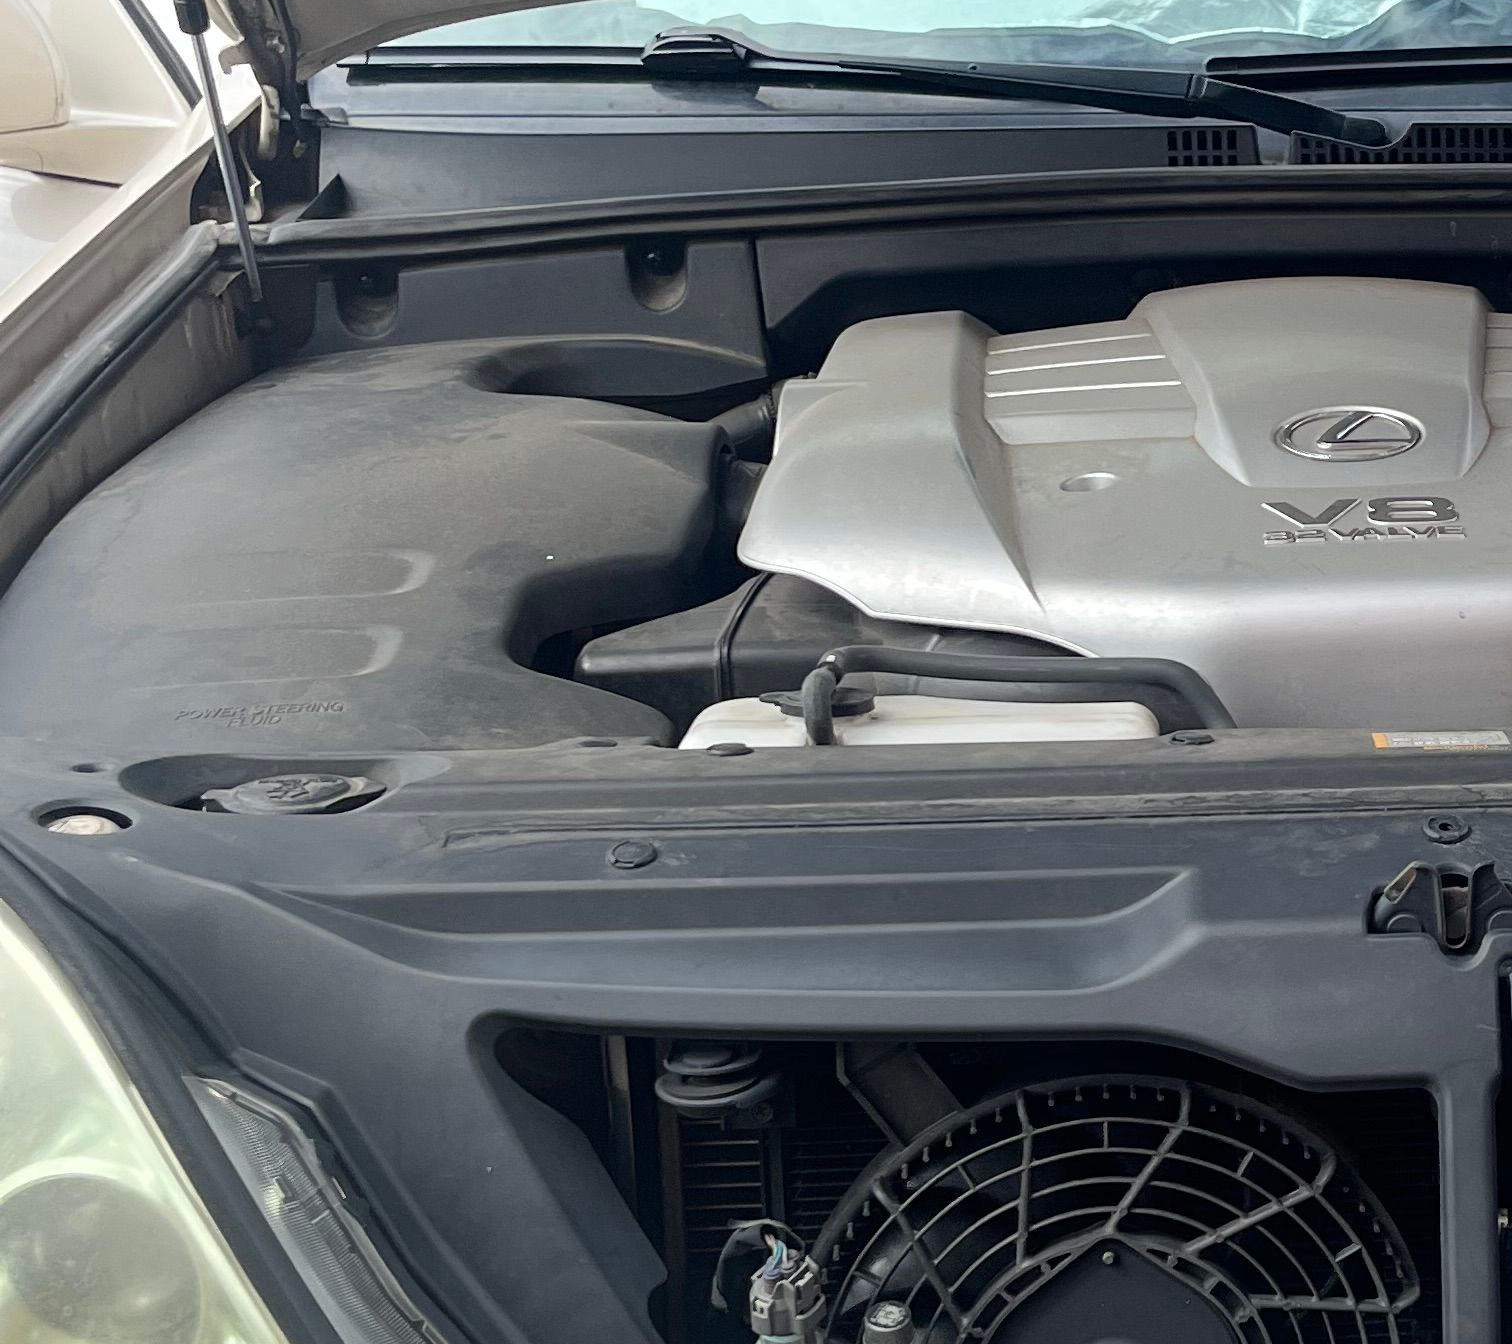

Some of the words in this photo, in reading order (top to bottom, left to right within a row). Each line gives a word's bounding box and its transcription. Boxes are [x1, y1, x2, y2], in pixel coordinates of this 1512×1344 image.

[1261, 497, 1460, 528] V8
[174, 705, 247, 721] POWER
[253, 701, 344, 717] STEERING
[226, 714, 283, 729] FLUID
